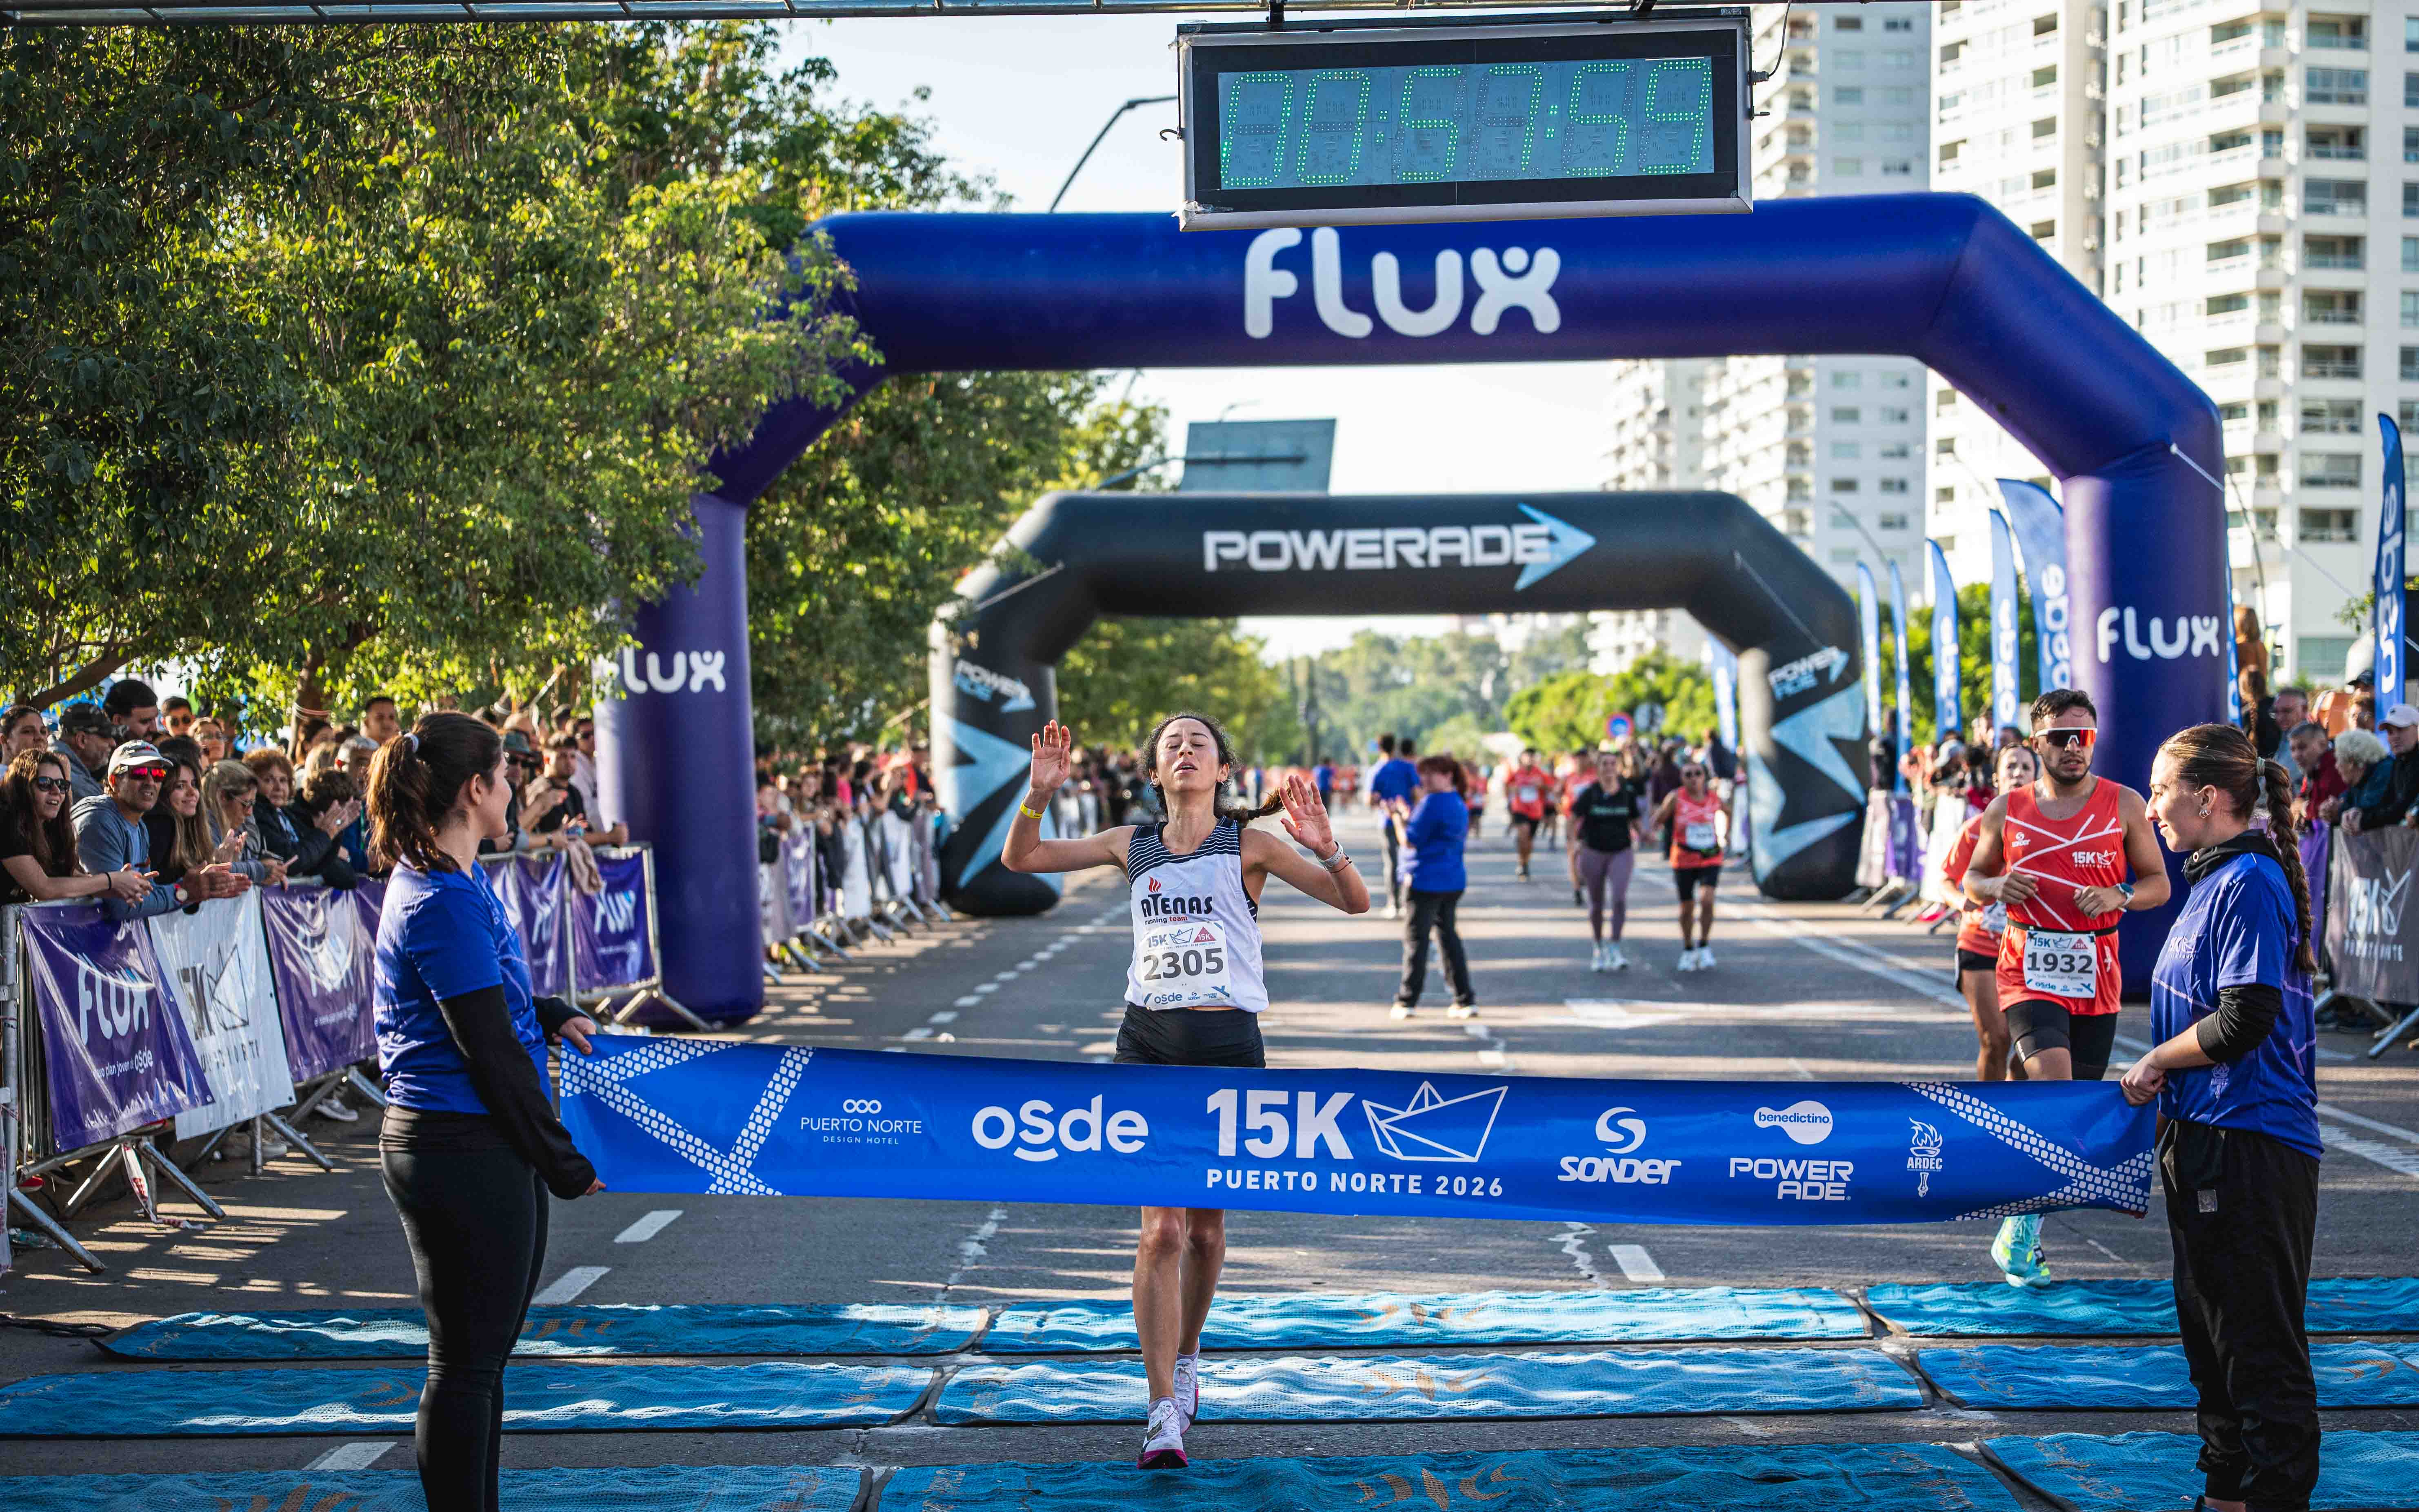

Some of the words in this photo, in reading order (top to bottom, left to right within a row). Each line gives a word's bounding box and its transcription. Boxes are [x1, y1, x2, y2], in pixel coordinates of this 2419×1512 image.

[1221, 60, 1711, 186] 00:57:59
[1204, 525, 1552, 571] POWERADE
[2072, 851, 2096, 864] 15K
[1145, 917, 1167, 925] running
[1148, 934, 1169, 948] 15K
[2034, 938, 2051, 947] 15K
[1144, 948, 1224, 981] 2305
[2027, 952, 2093, 974] 1932
[1154, 992, 1182, 1004] osde
[105, 1062, 117, 1080] plan
[135, 1045, 153, 1074] osde
[800, 1117, 862, 1132] PUERTO
[868, 1120, 922, 1134] NORTE
[972, 1094, 1149, 1162] osde
[1207, 1088, 1355, 1159] 15K
[1759, 1111, 1832, 1124] benedictino
[1729, 1158, 1854, 1181] POWER
[1907, 1157, 1943, 1169] ARDEC
[1207, 1169, 1318, 1192] PUERTO
[1331, 1172, 1422, 1194] NORTE
[1436, 1176, 1503, 1197] 2026
